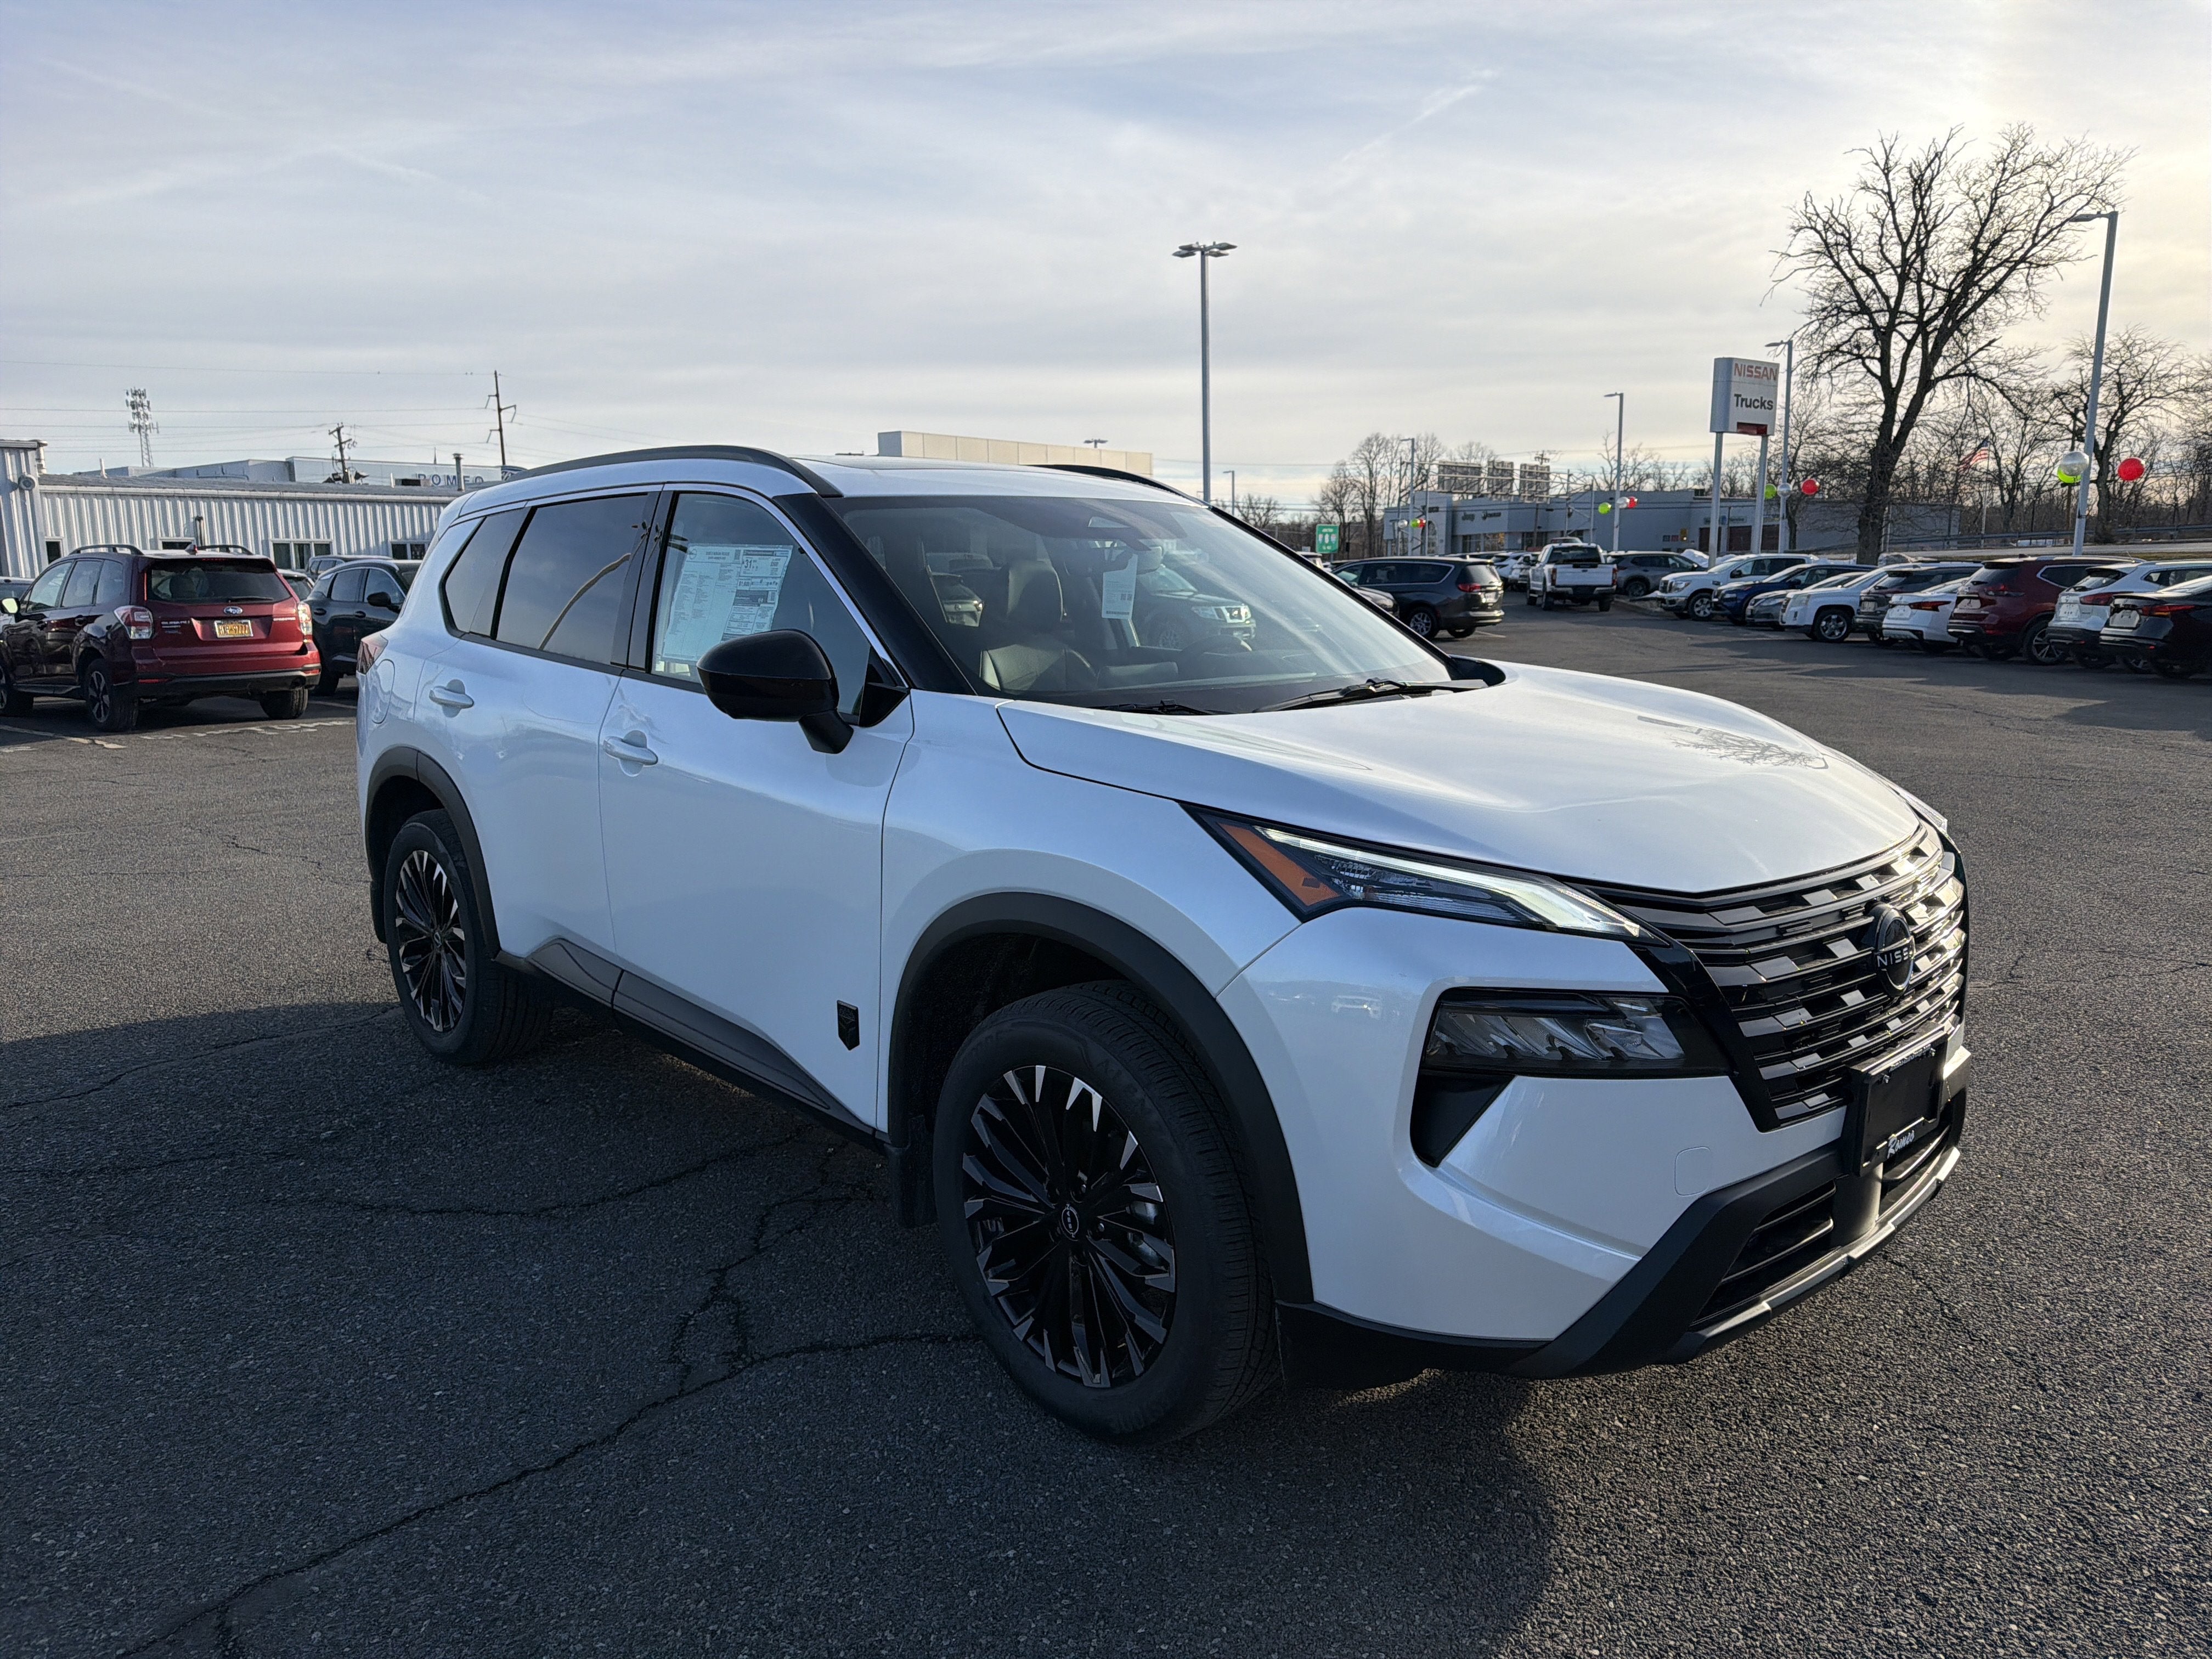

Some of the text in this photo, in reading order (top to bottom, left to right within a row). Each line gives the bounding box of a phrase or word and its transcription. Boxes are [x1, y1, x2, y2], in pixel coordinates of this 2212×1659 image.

[1734, 363, 1778, 380] NISSAN
[1734, 393, 1774, 410] Trucks
[1877, 945, 1912, 967] NISS
[1887, 1130, 1915, 1159] Romeo
